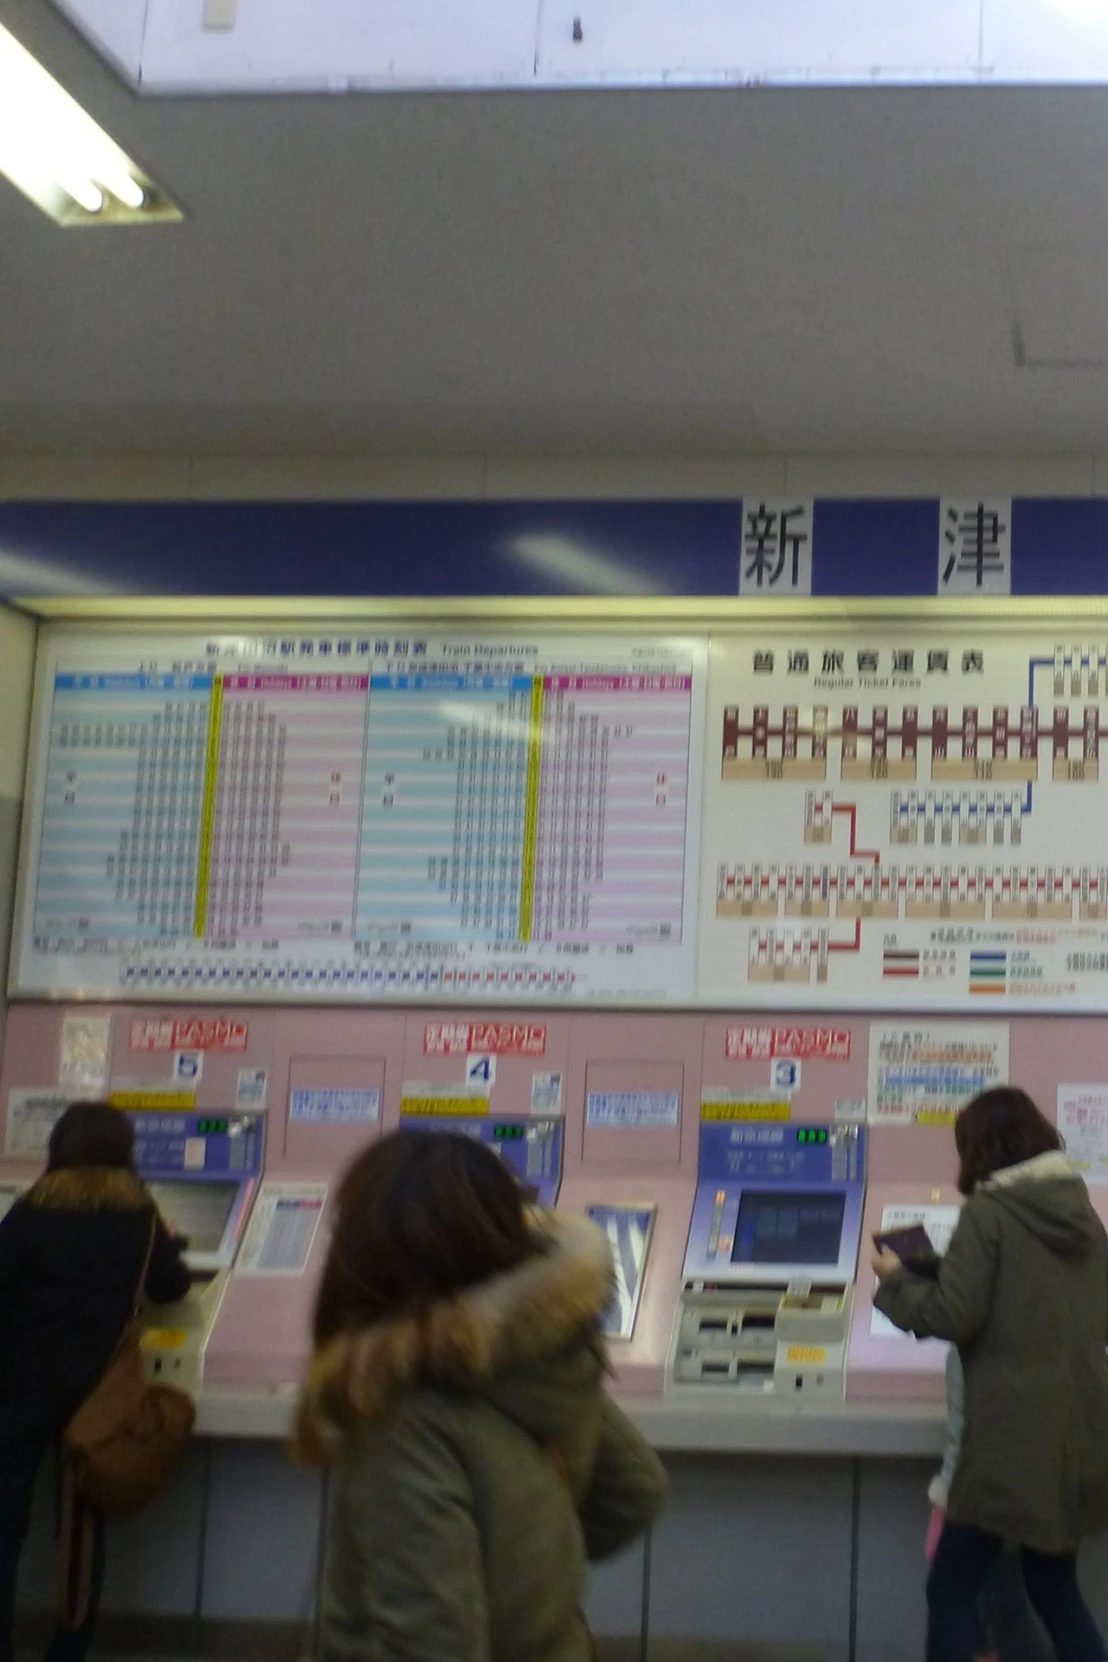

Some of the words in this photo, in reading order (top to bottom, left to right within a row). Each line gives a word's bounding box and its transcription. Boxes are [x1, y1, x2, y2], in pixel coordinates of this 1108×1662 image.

[752, 648, 984, 675] 普通旅客運賃表
[178, 1054, 199, 1078] 5
[469, 1055, 491, 1080] 4
[774, 1059, 797, 1088] 3
